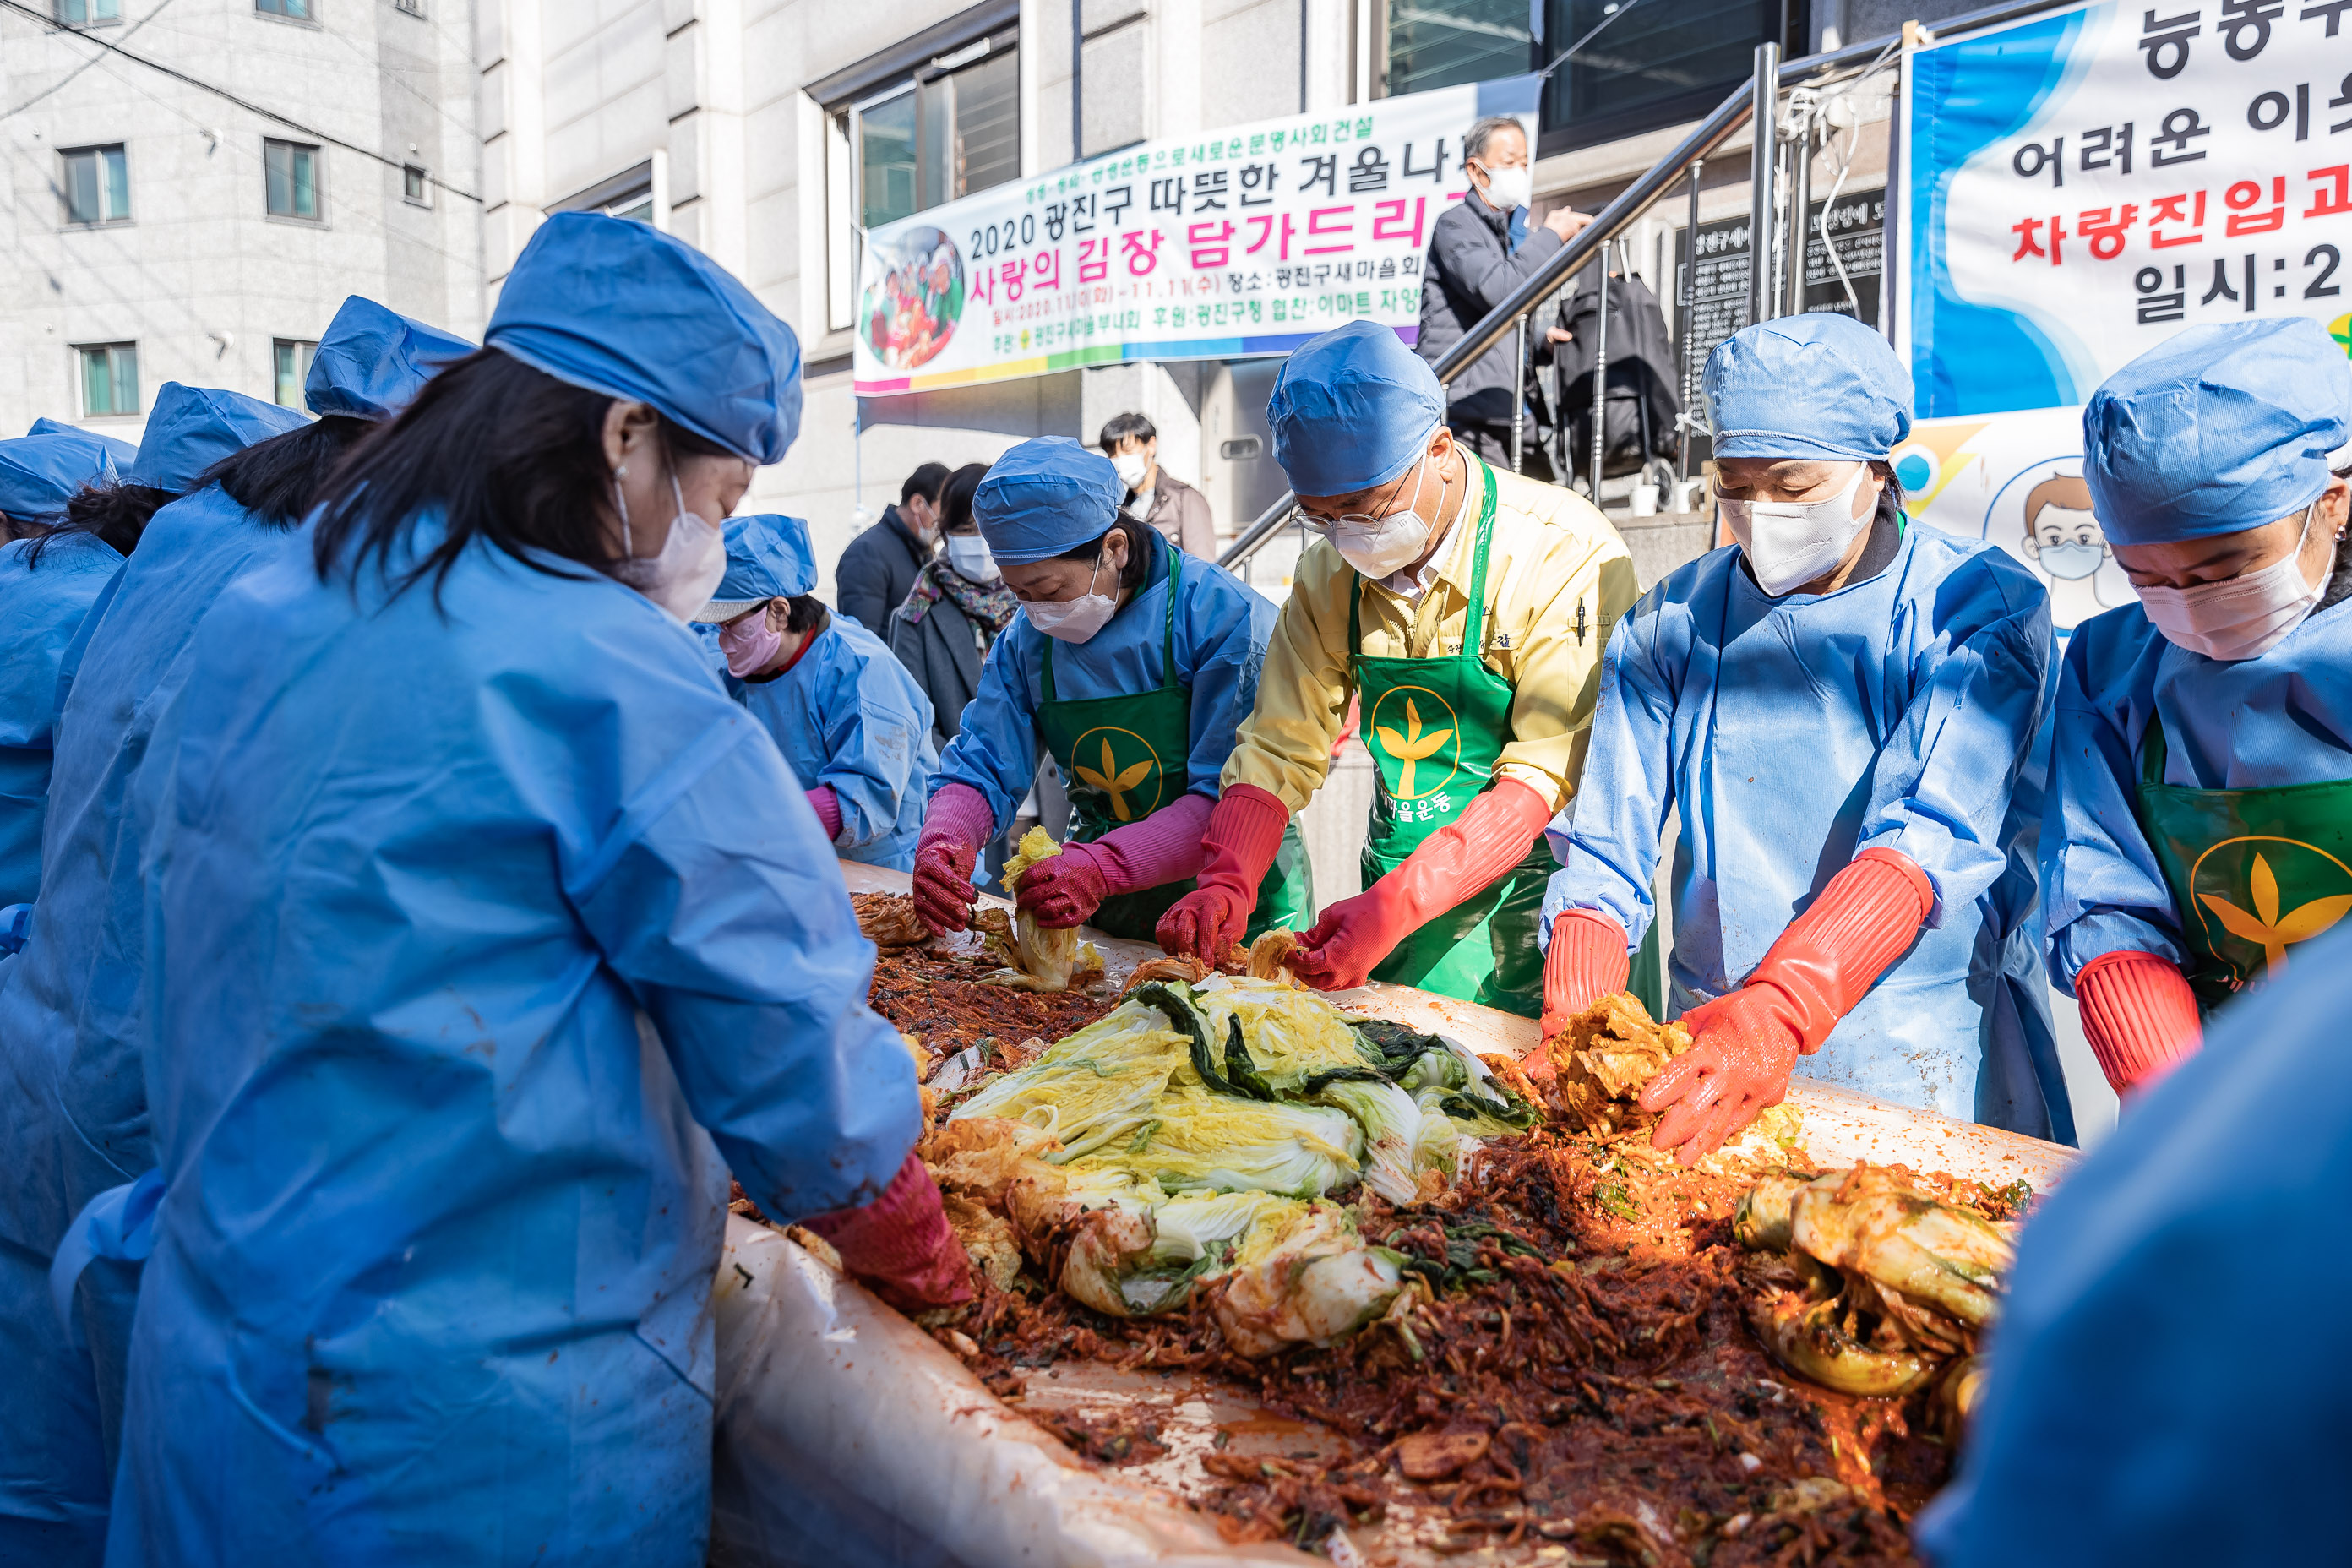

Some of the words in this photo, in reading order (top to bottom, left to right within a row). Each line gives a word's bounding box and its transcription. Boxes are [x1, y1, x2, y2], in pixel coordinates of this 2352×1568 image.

[2012, 107, 2211, 188] 어려운
[971, 214, 1035, 260] 2020
[1044, 185, 1132, 241] 광진구
[1150, 163, 1280, 215] 따뜻한
[1298, 135, 1468, 197] 겨울나
[970, 248, 1059, 306] 사랑의
[1078, 228, 1165, 288] 김장
